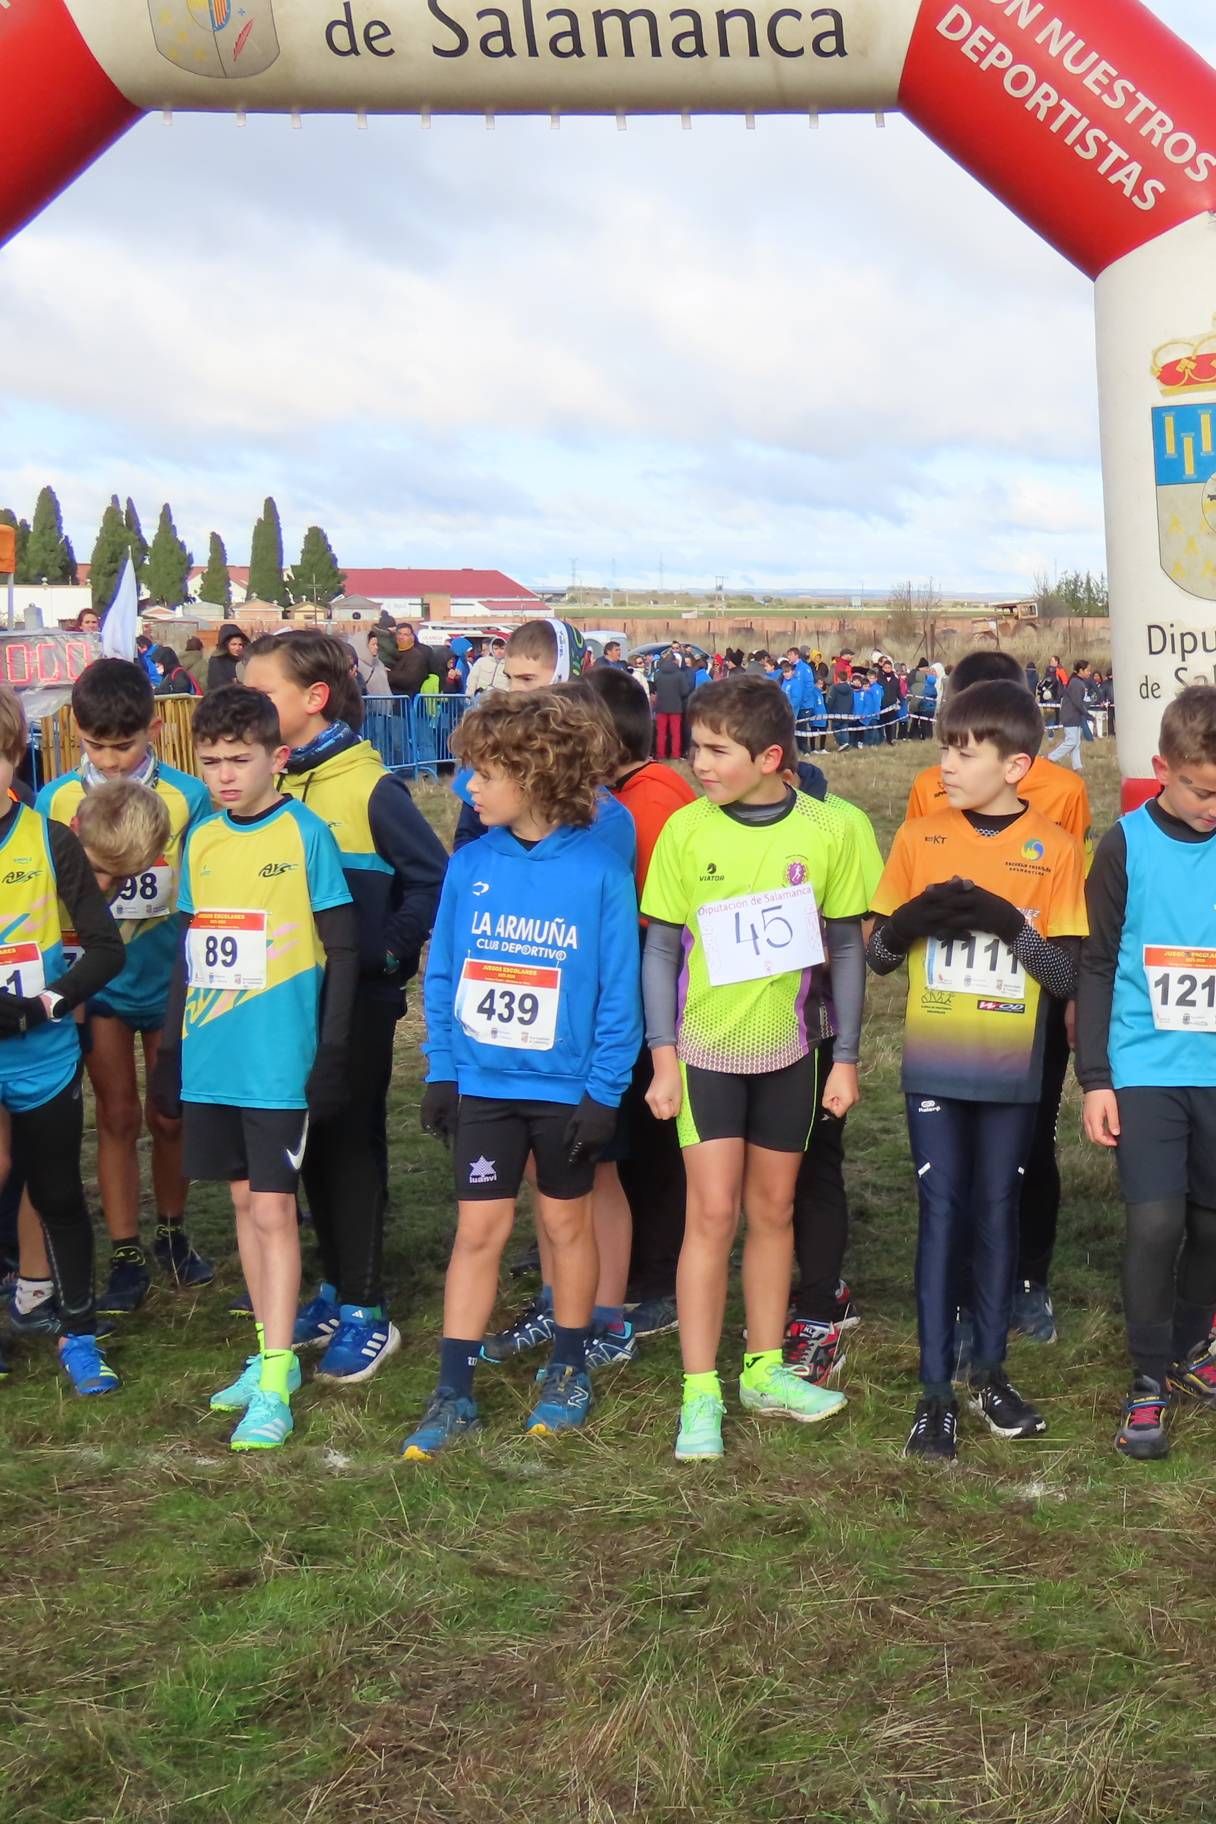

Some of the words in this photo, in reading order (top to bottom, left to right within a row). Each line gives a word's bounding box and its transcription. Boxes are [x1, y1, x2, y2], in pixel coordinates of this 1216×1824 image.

[325, 1, 395, 58] de
[430, 0, 848, 59] Salamanca
[935, 4, 1166, 212] DEPORTISTAS
[1139, 674, 1161, 699] de
[119, 872, 158, 900] 98
[471, 911, 492, 936] LA
[495, 914, 578, 949] ARMUÑA
[734, 904, 793, 956] 45
[205, 935, 239, 968] 89
[476, 938, 499, 951] CLUB
[501, 941, 567, 961] DEPORTIVO
[0, 969, 25, 999] 1
[476, 988, 540, 1026] 439
[469, 1173, 498, 1184] luanvi
